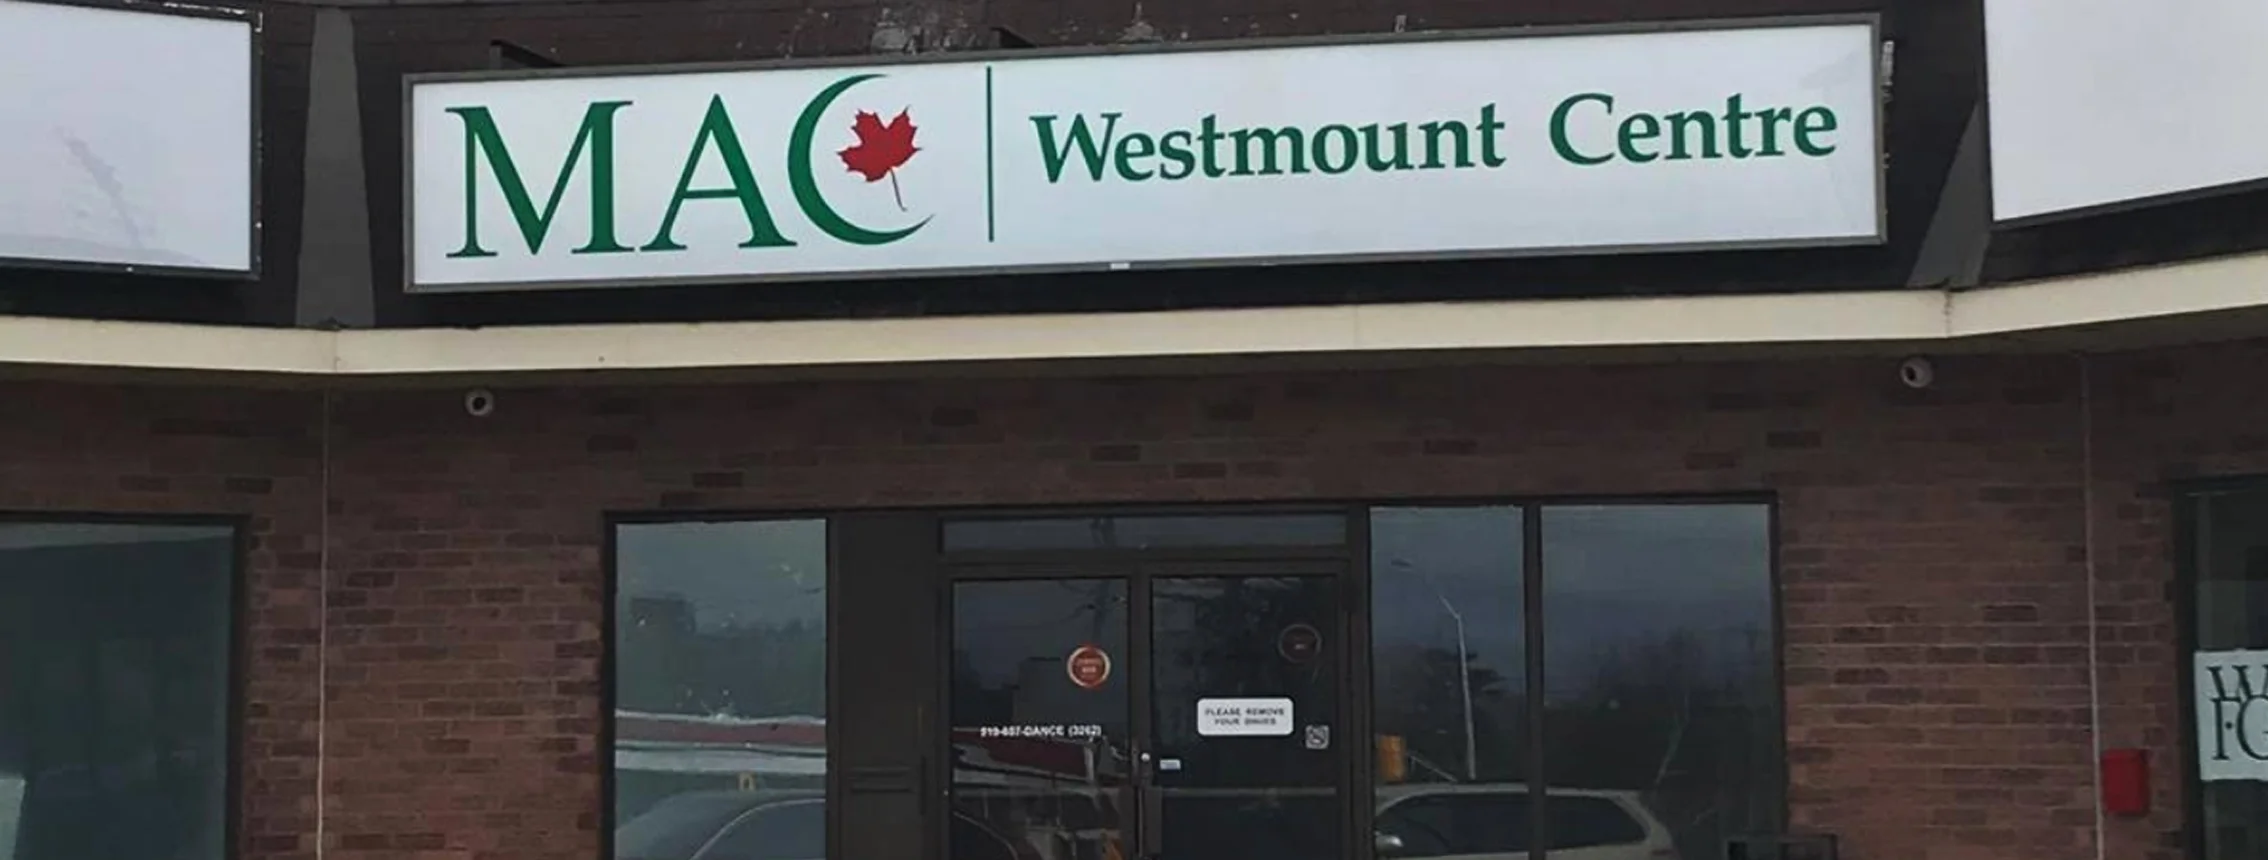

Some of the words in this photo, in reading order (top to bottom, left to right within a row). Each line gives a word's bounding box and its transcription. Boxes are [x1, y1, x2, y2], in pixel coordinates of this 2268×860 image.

[1029, 102, 1506, 183] Westmount
[1550, 92, 1838, 166] Centre
[445, 74, 935, 257] MAC
[1205, 707, 1241, 716] PLEASE
[1246, 707, 1285, 716] REMOVE
[1214, 717, 1240, 726] YOUR
